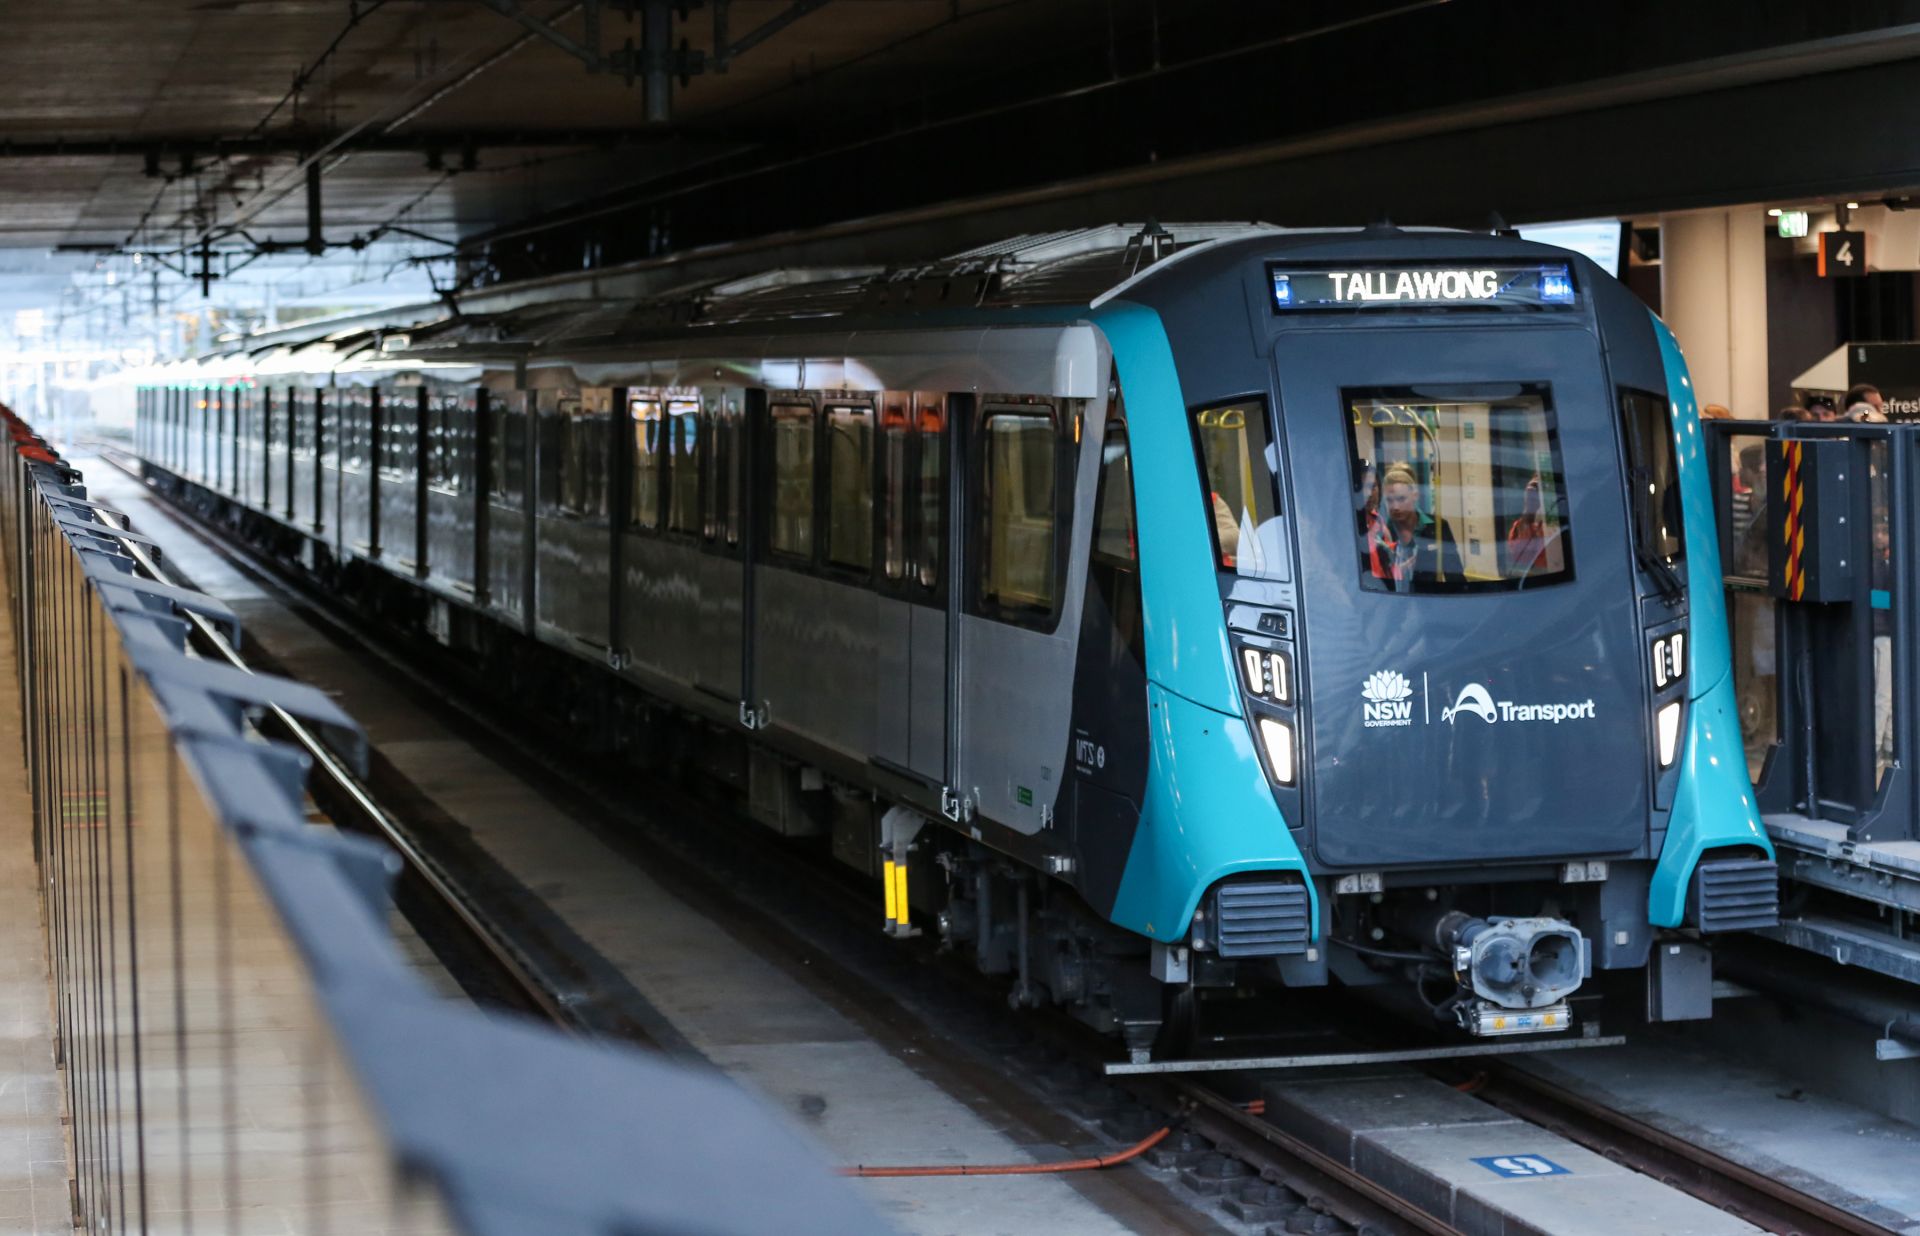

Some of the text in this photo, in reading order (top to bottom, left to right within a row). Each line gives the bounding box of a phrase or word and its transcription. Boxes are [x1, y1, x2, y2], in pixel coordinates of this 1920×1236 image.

[1836, 240, 1854, 266] 4
[1328, 271, 1497, 300] TALLAWONG
[1882, 397, 1920, 414] efres
[1364, 702, 1412, 720] NSW
[1497, 699, 1596, 724] Transport
[1364, 719, 1411, 728] GOVERNMENT
